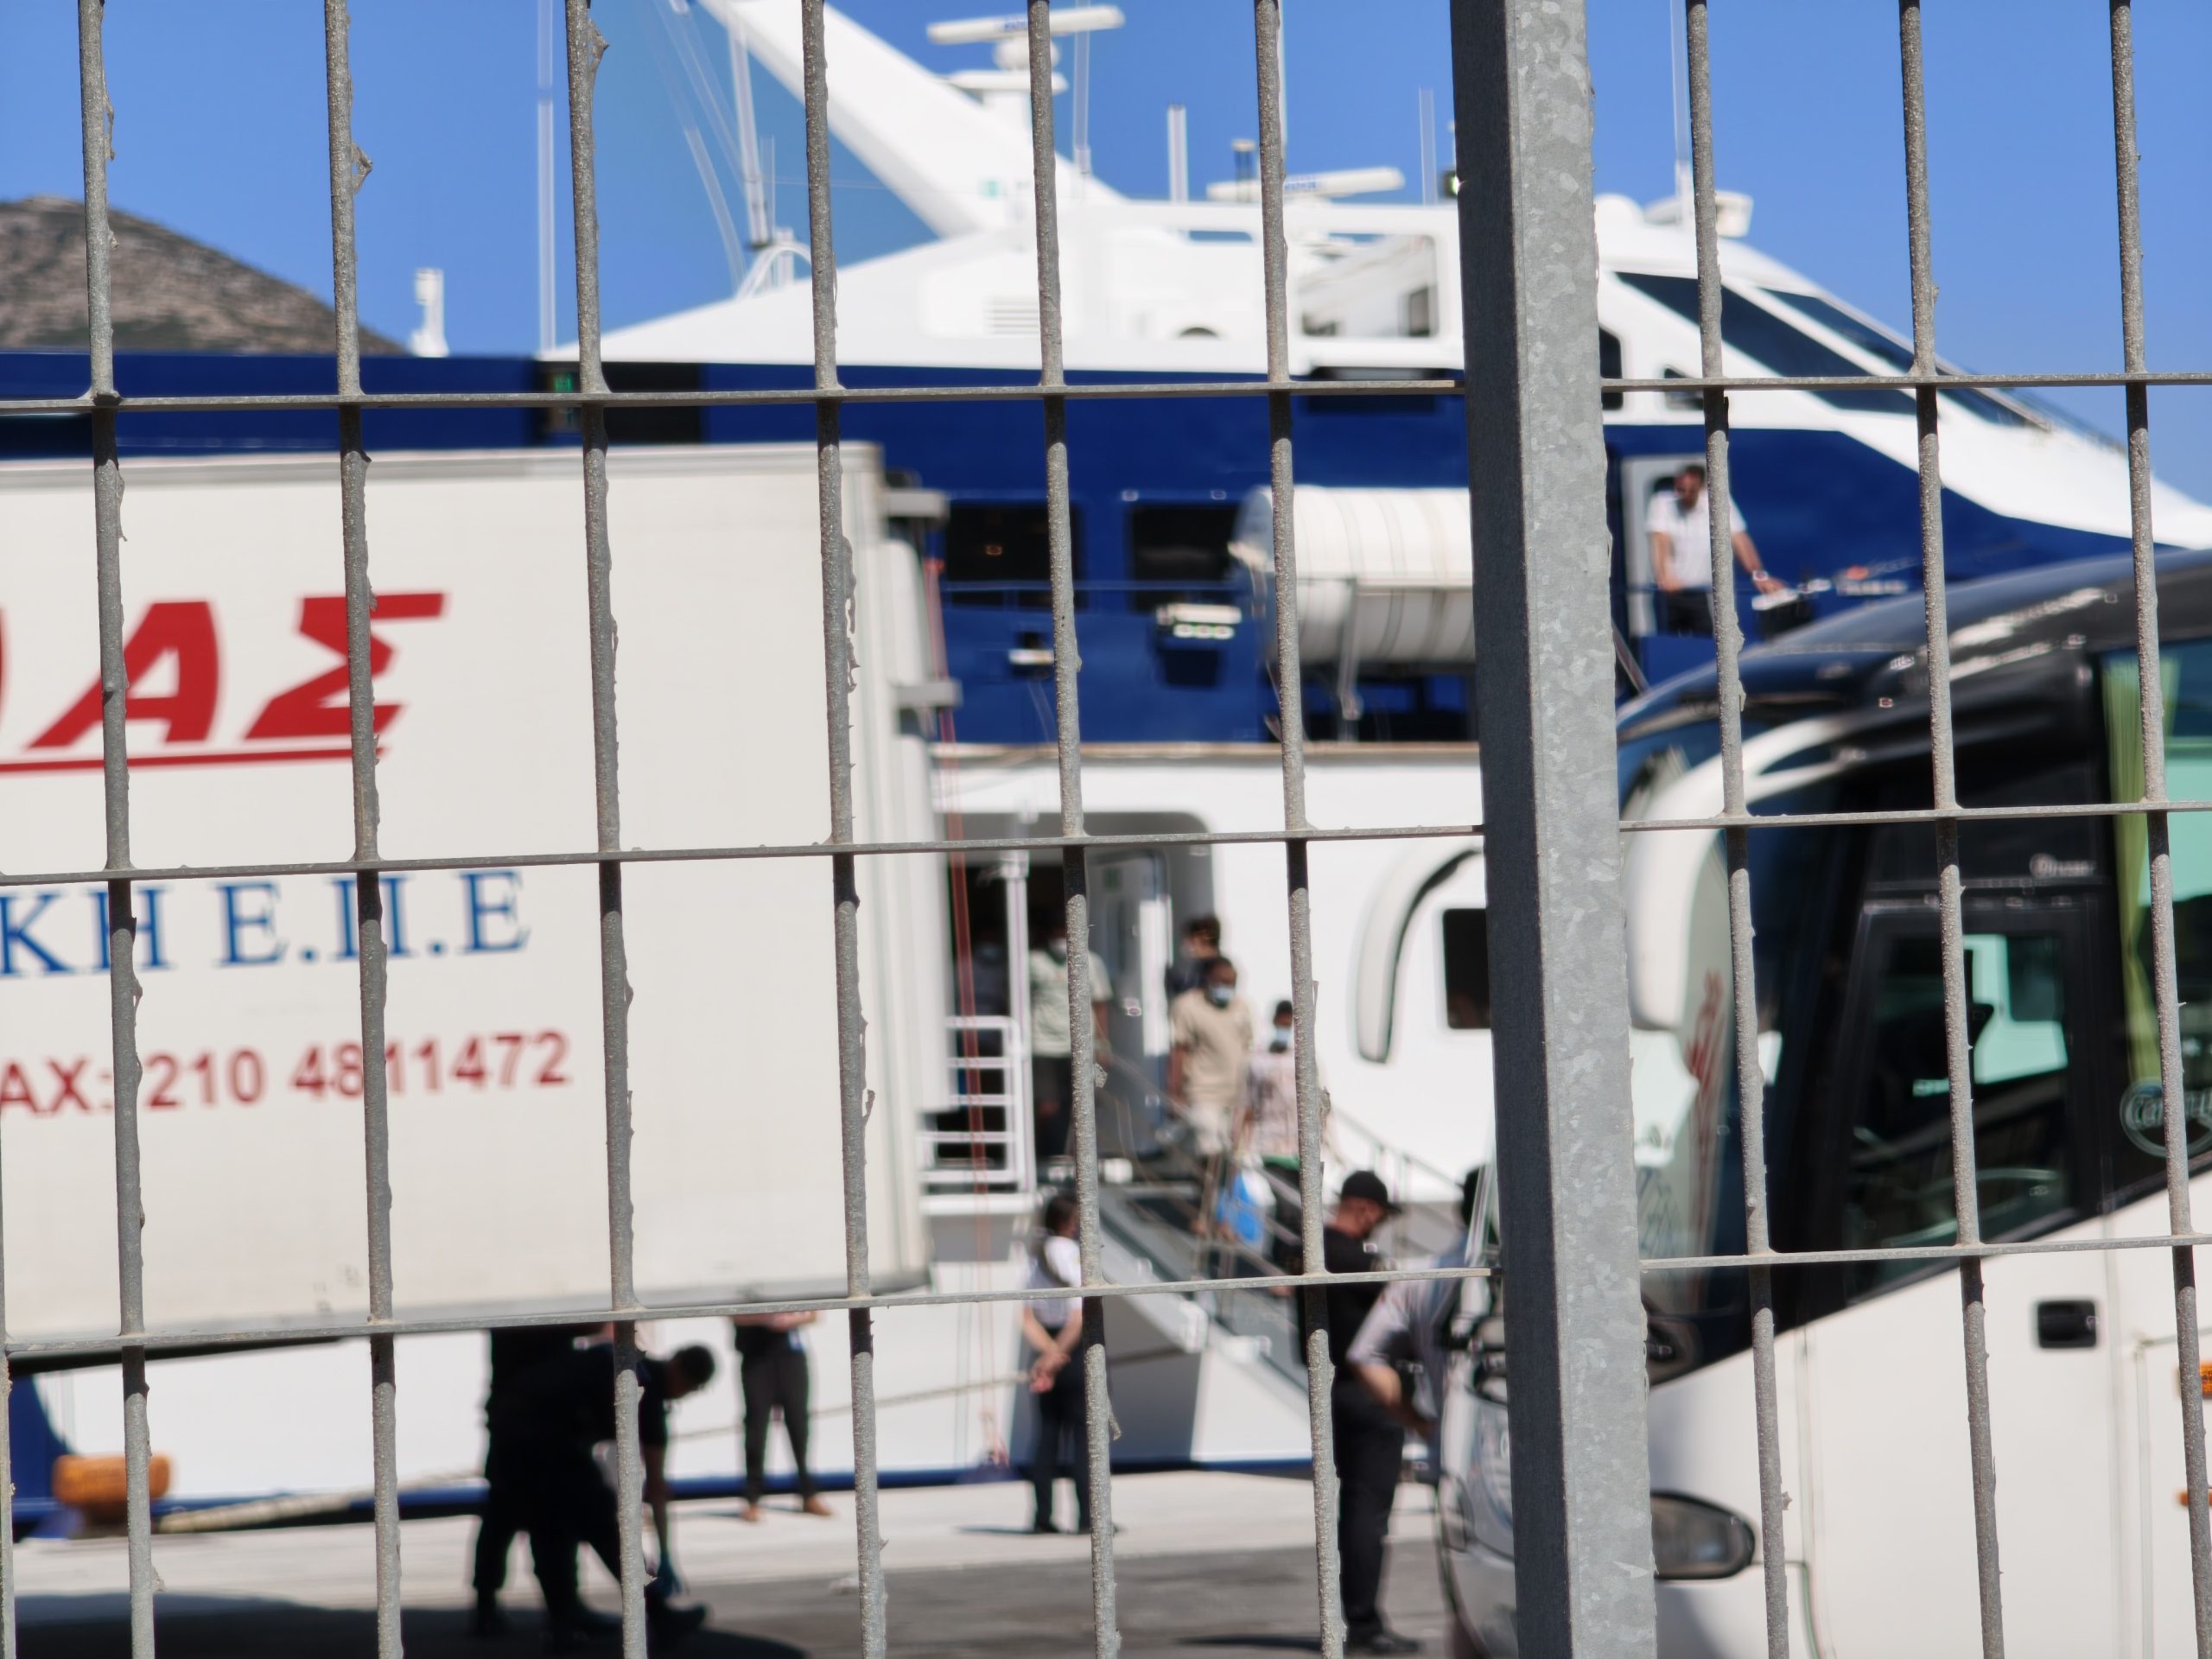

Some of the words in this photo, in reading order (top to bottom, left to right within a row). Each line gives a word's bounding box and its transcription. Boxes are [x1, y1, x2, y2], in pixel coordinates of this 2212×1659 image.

[0, 592, 448, 748] ΑΣ
[145, 1049, 266, 1110] 210
[290, 1031, 570, 1098] 4811472
